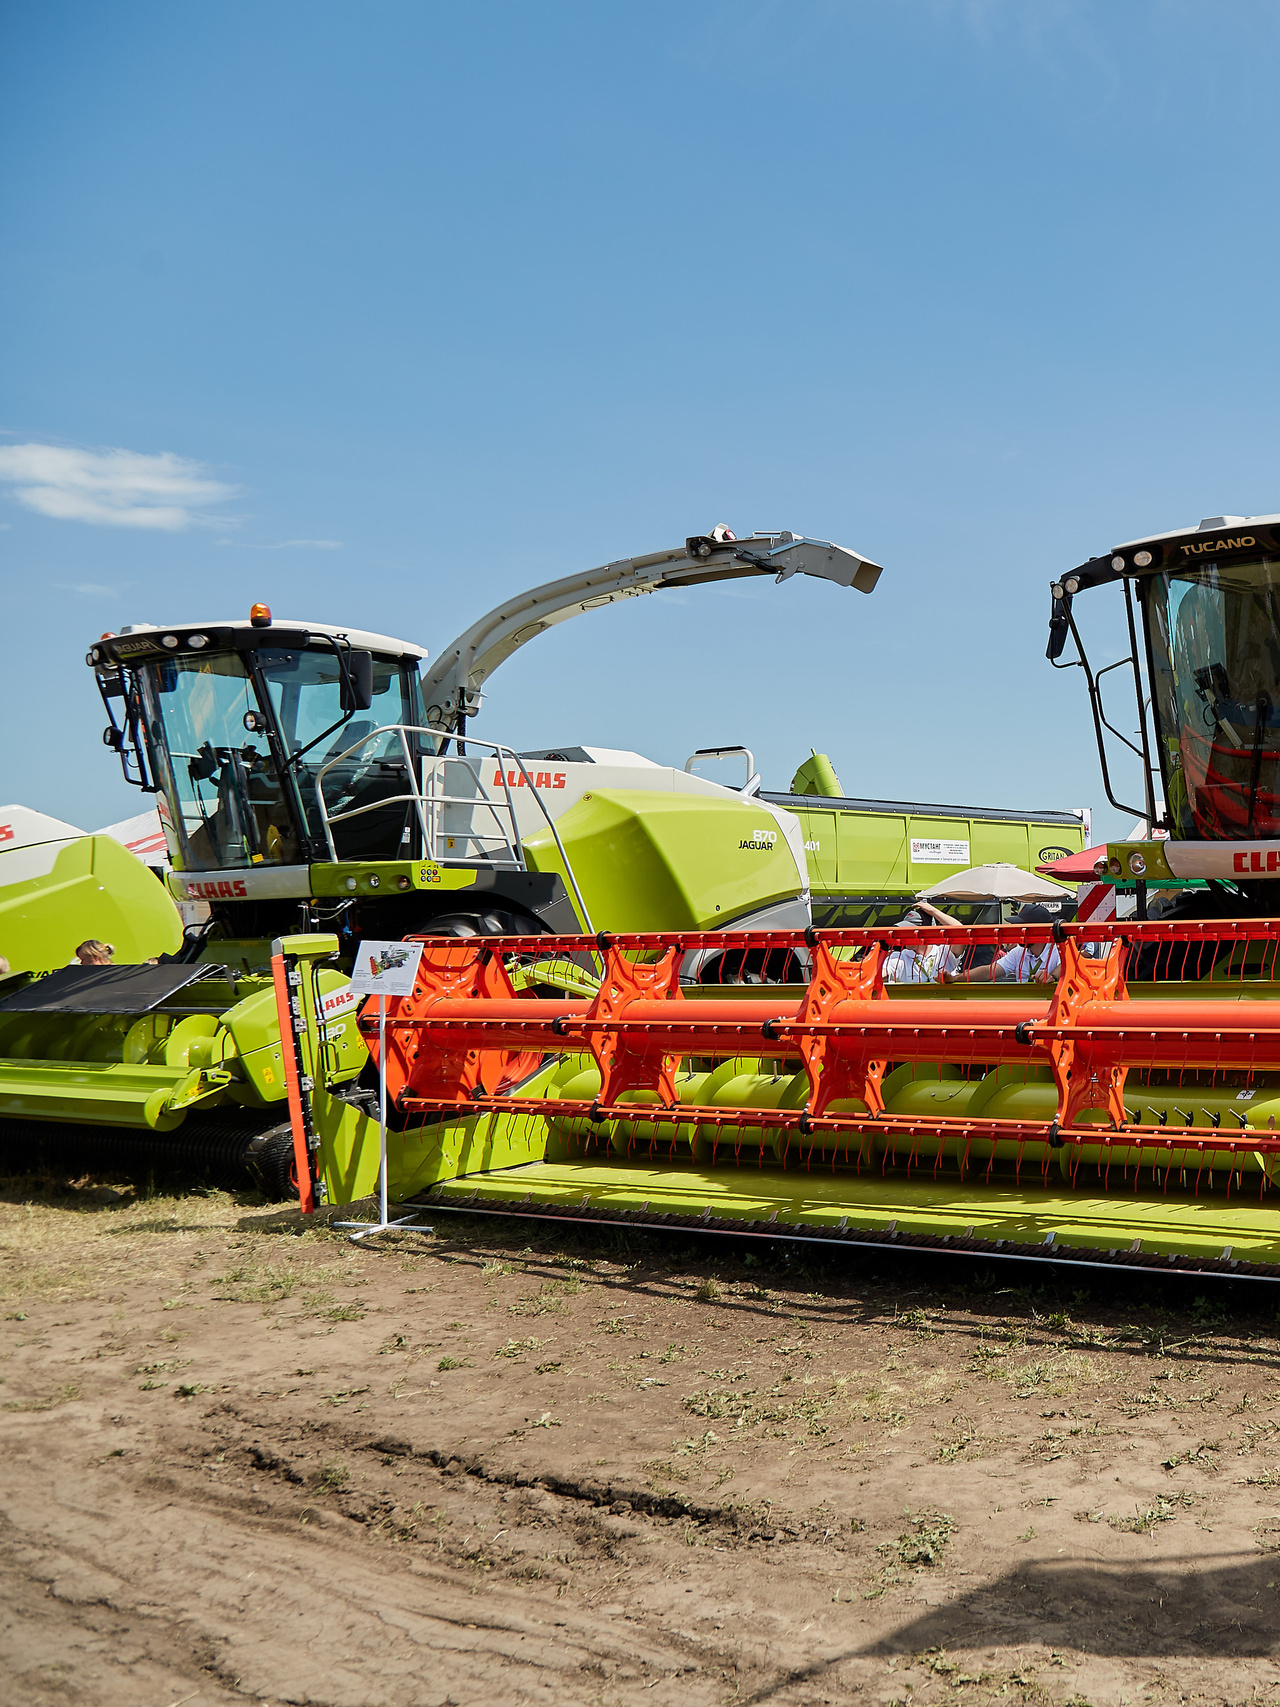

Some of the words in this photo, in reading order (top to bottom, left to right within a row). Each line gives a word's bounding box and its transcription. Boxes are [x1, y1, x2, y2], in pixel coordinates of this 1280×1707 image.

[1180, 536, 1256, 555] TUCANO
[493, 770, 567, 789] CLAAS
[753, 829, 777, 843] 870
[738, 840, 773, 851] JAGUAR
